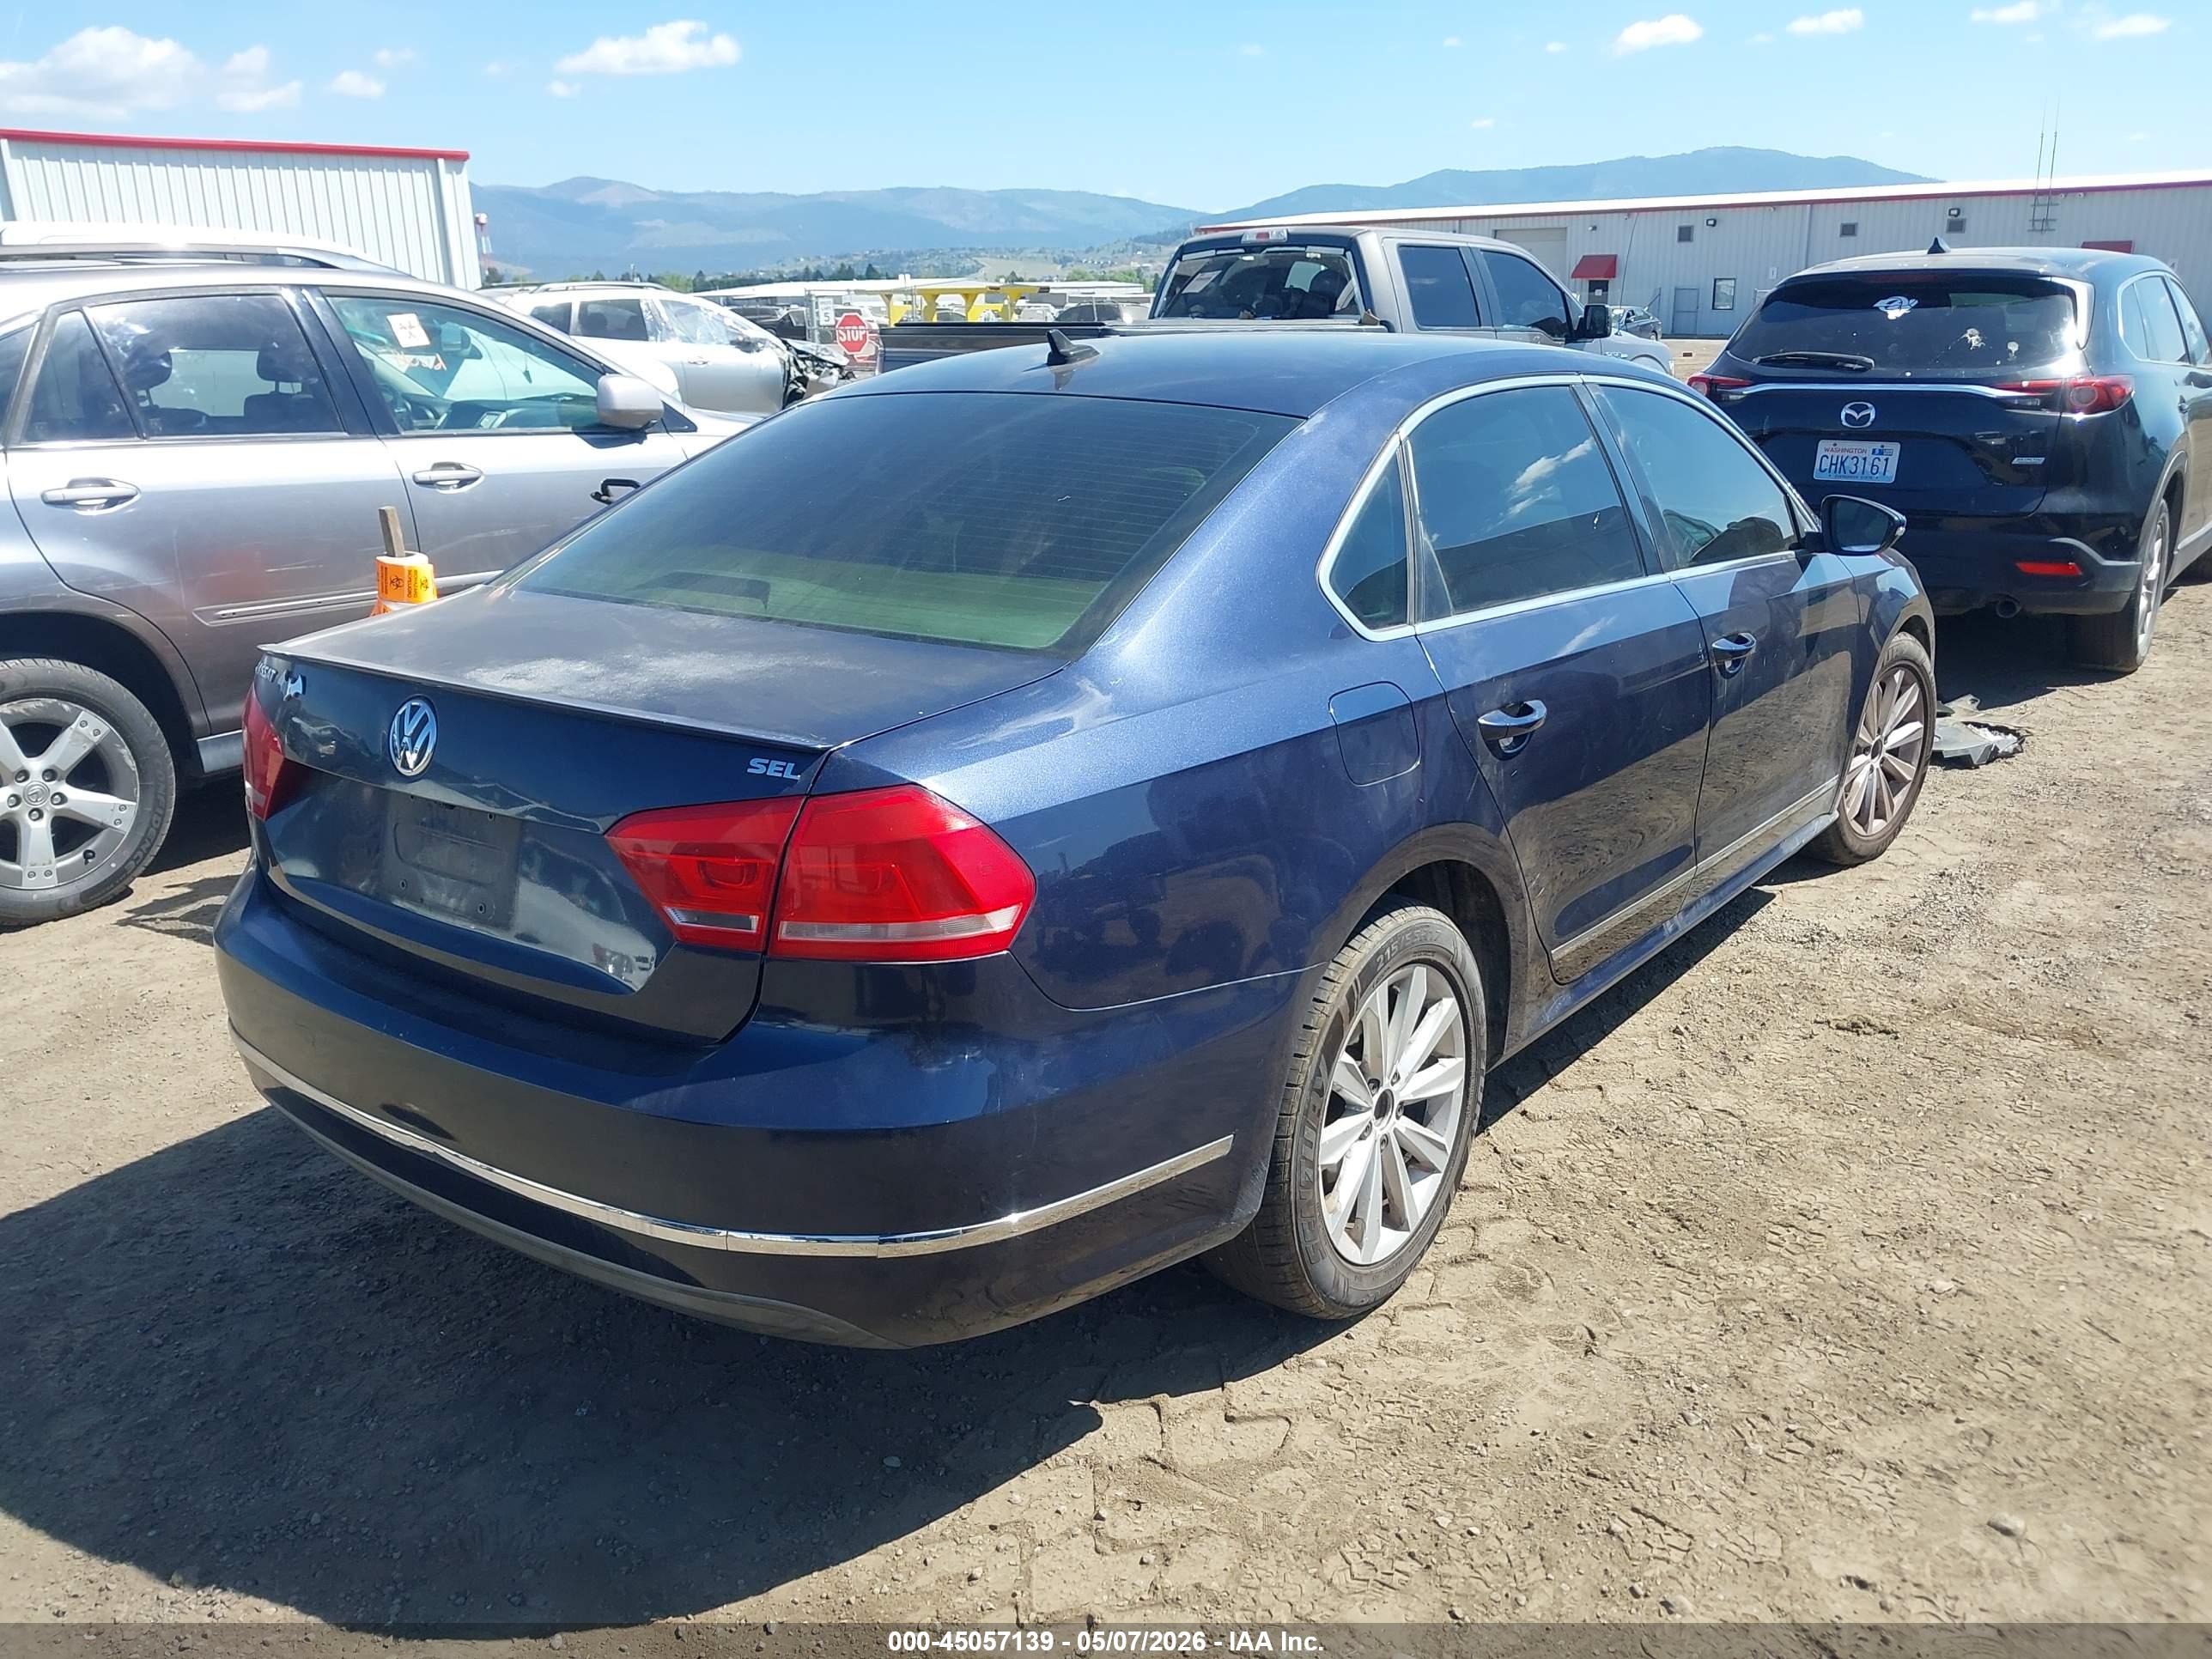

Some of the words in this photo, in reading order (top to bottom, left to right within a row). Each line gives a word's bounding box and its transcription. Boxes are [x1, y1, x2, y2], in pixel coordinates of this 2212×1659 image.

[838, 326, 866, 342] STOP
[1819, 454, 1890, 476] CHK3161
[746, 757, 801, 781] SEL
